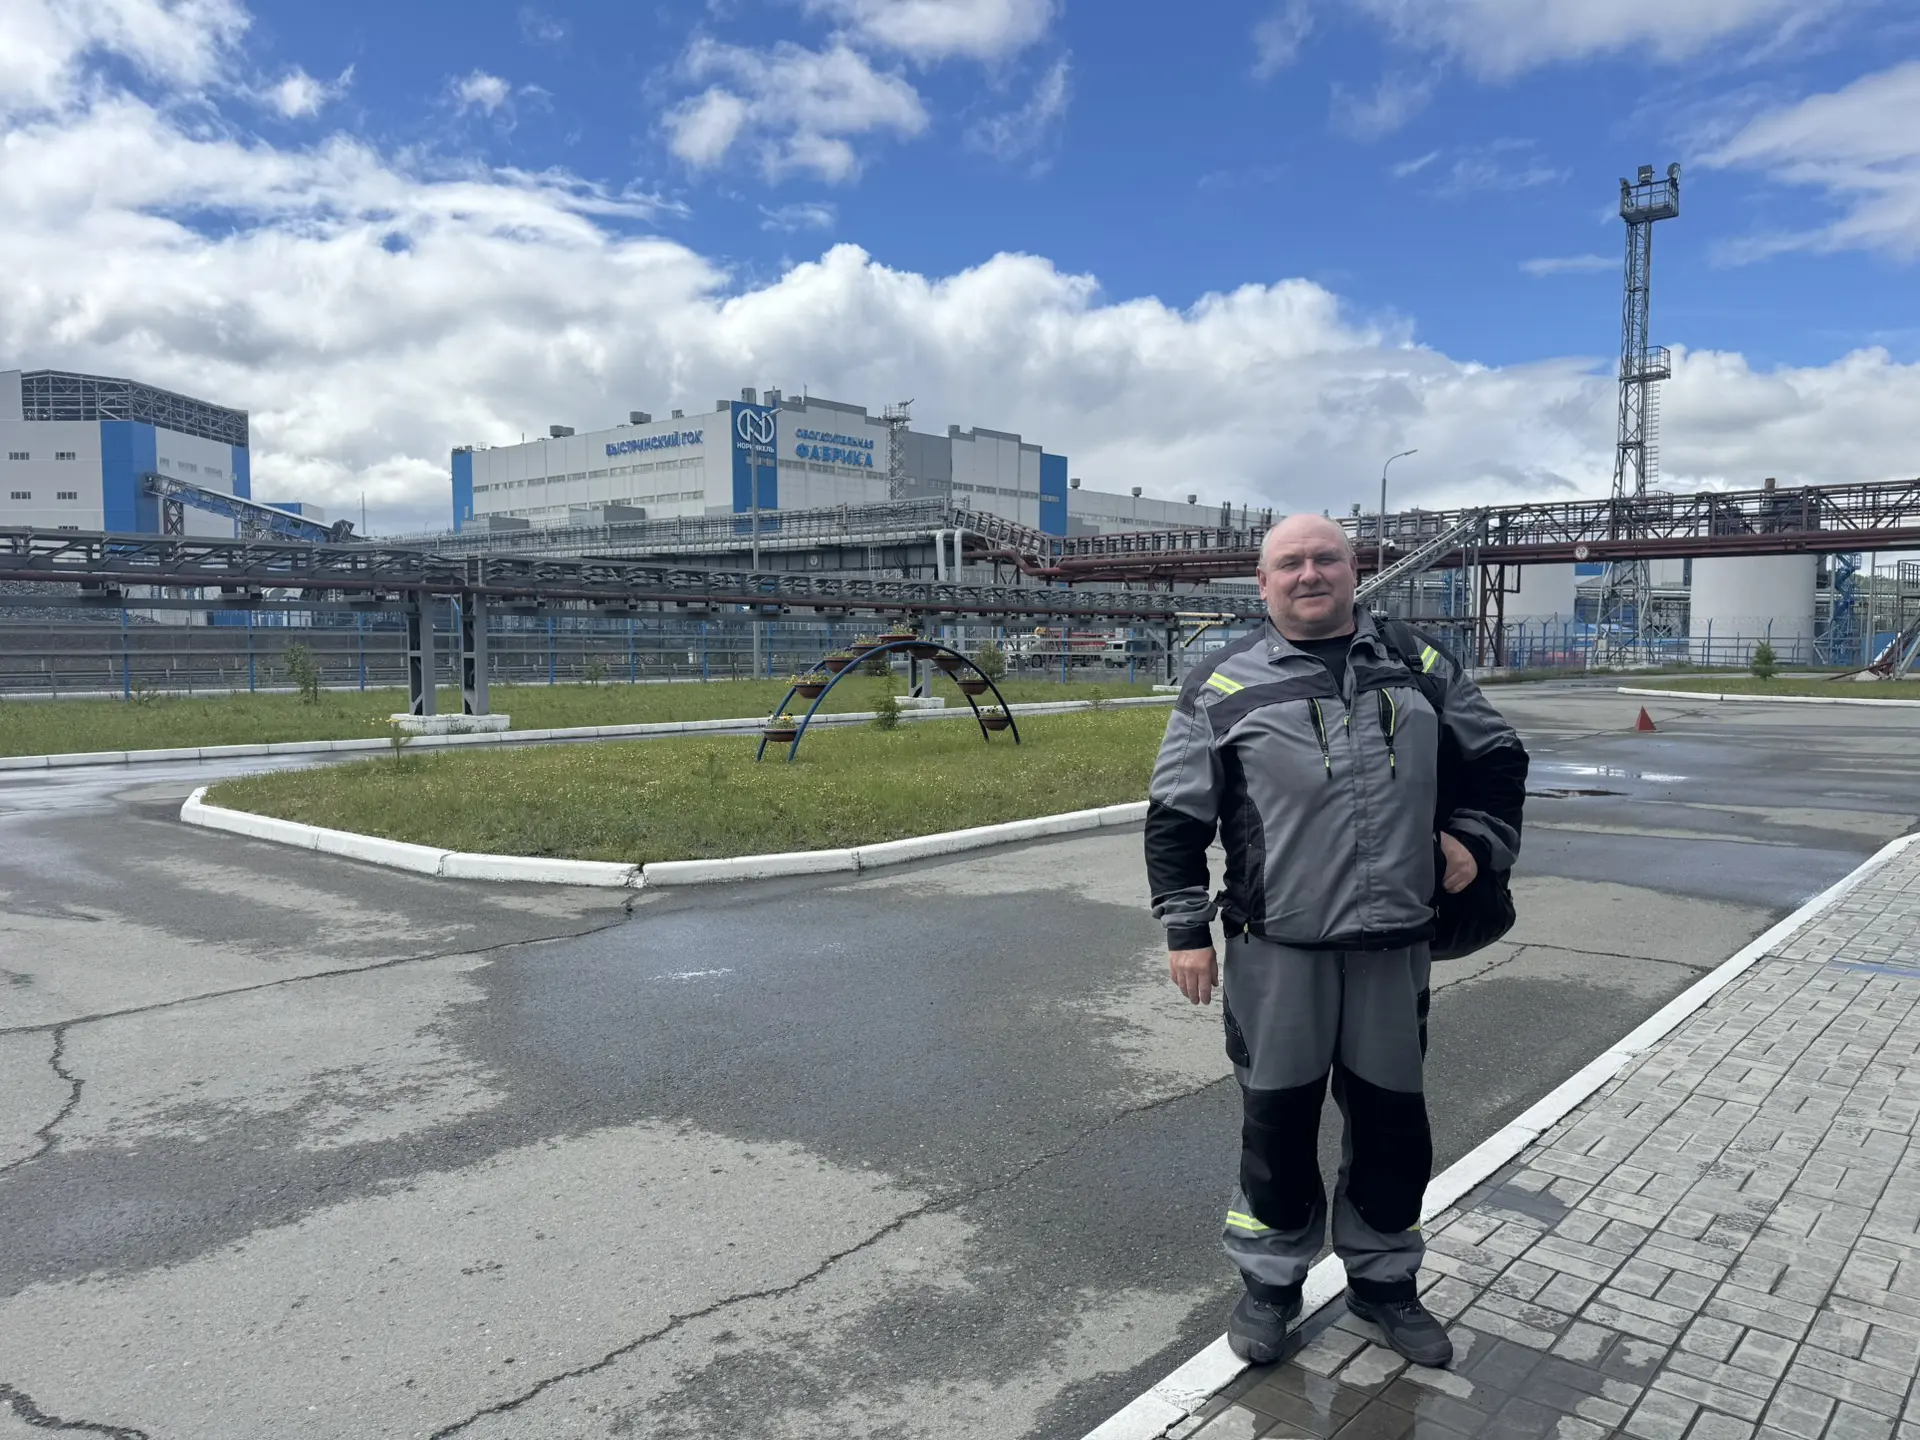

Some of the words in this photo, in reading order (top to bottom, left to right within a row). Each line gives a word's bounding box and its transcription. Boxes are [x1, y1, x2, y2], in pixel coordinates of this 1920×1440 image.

[605, 431, 680, 456] БЫСТРИНСКИЙ
[681, 430, 703, 446] ГОК
[795, 442, 874, 468] ФАБРИКА
